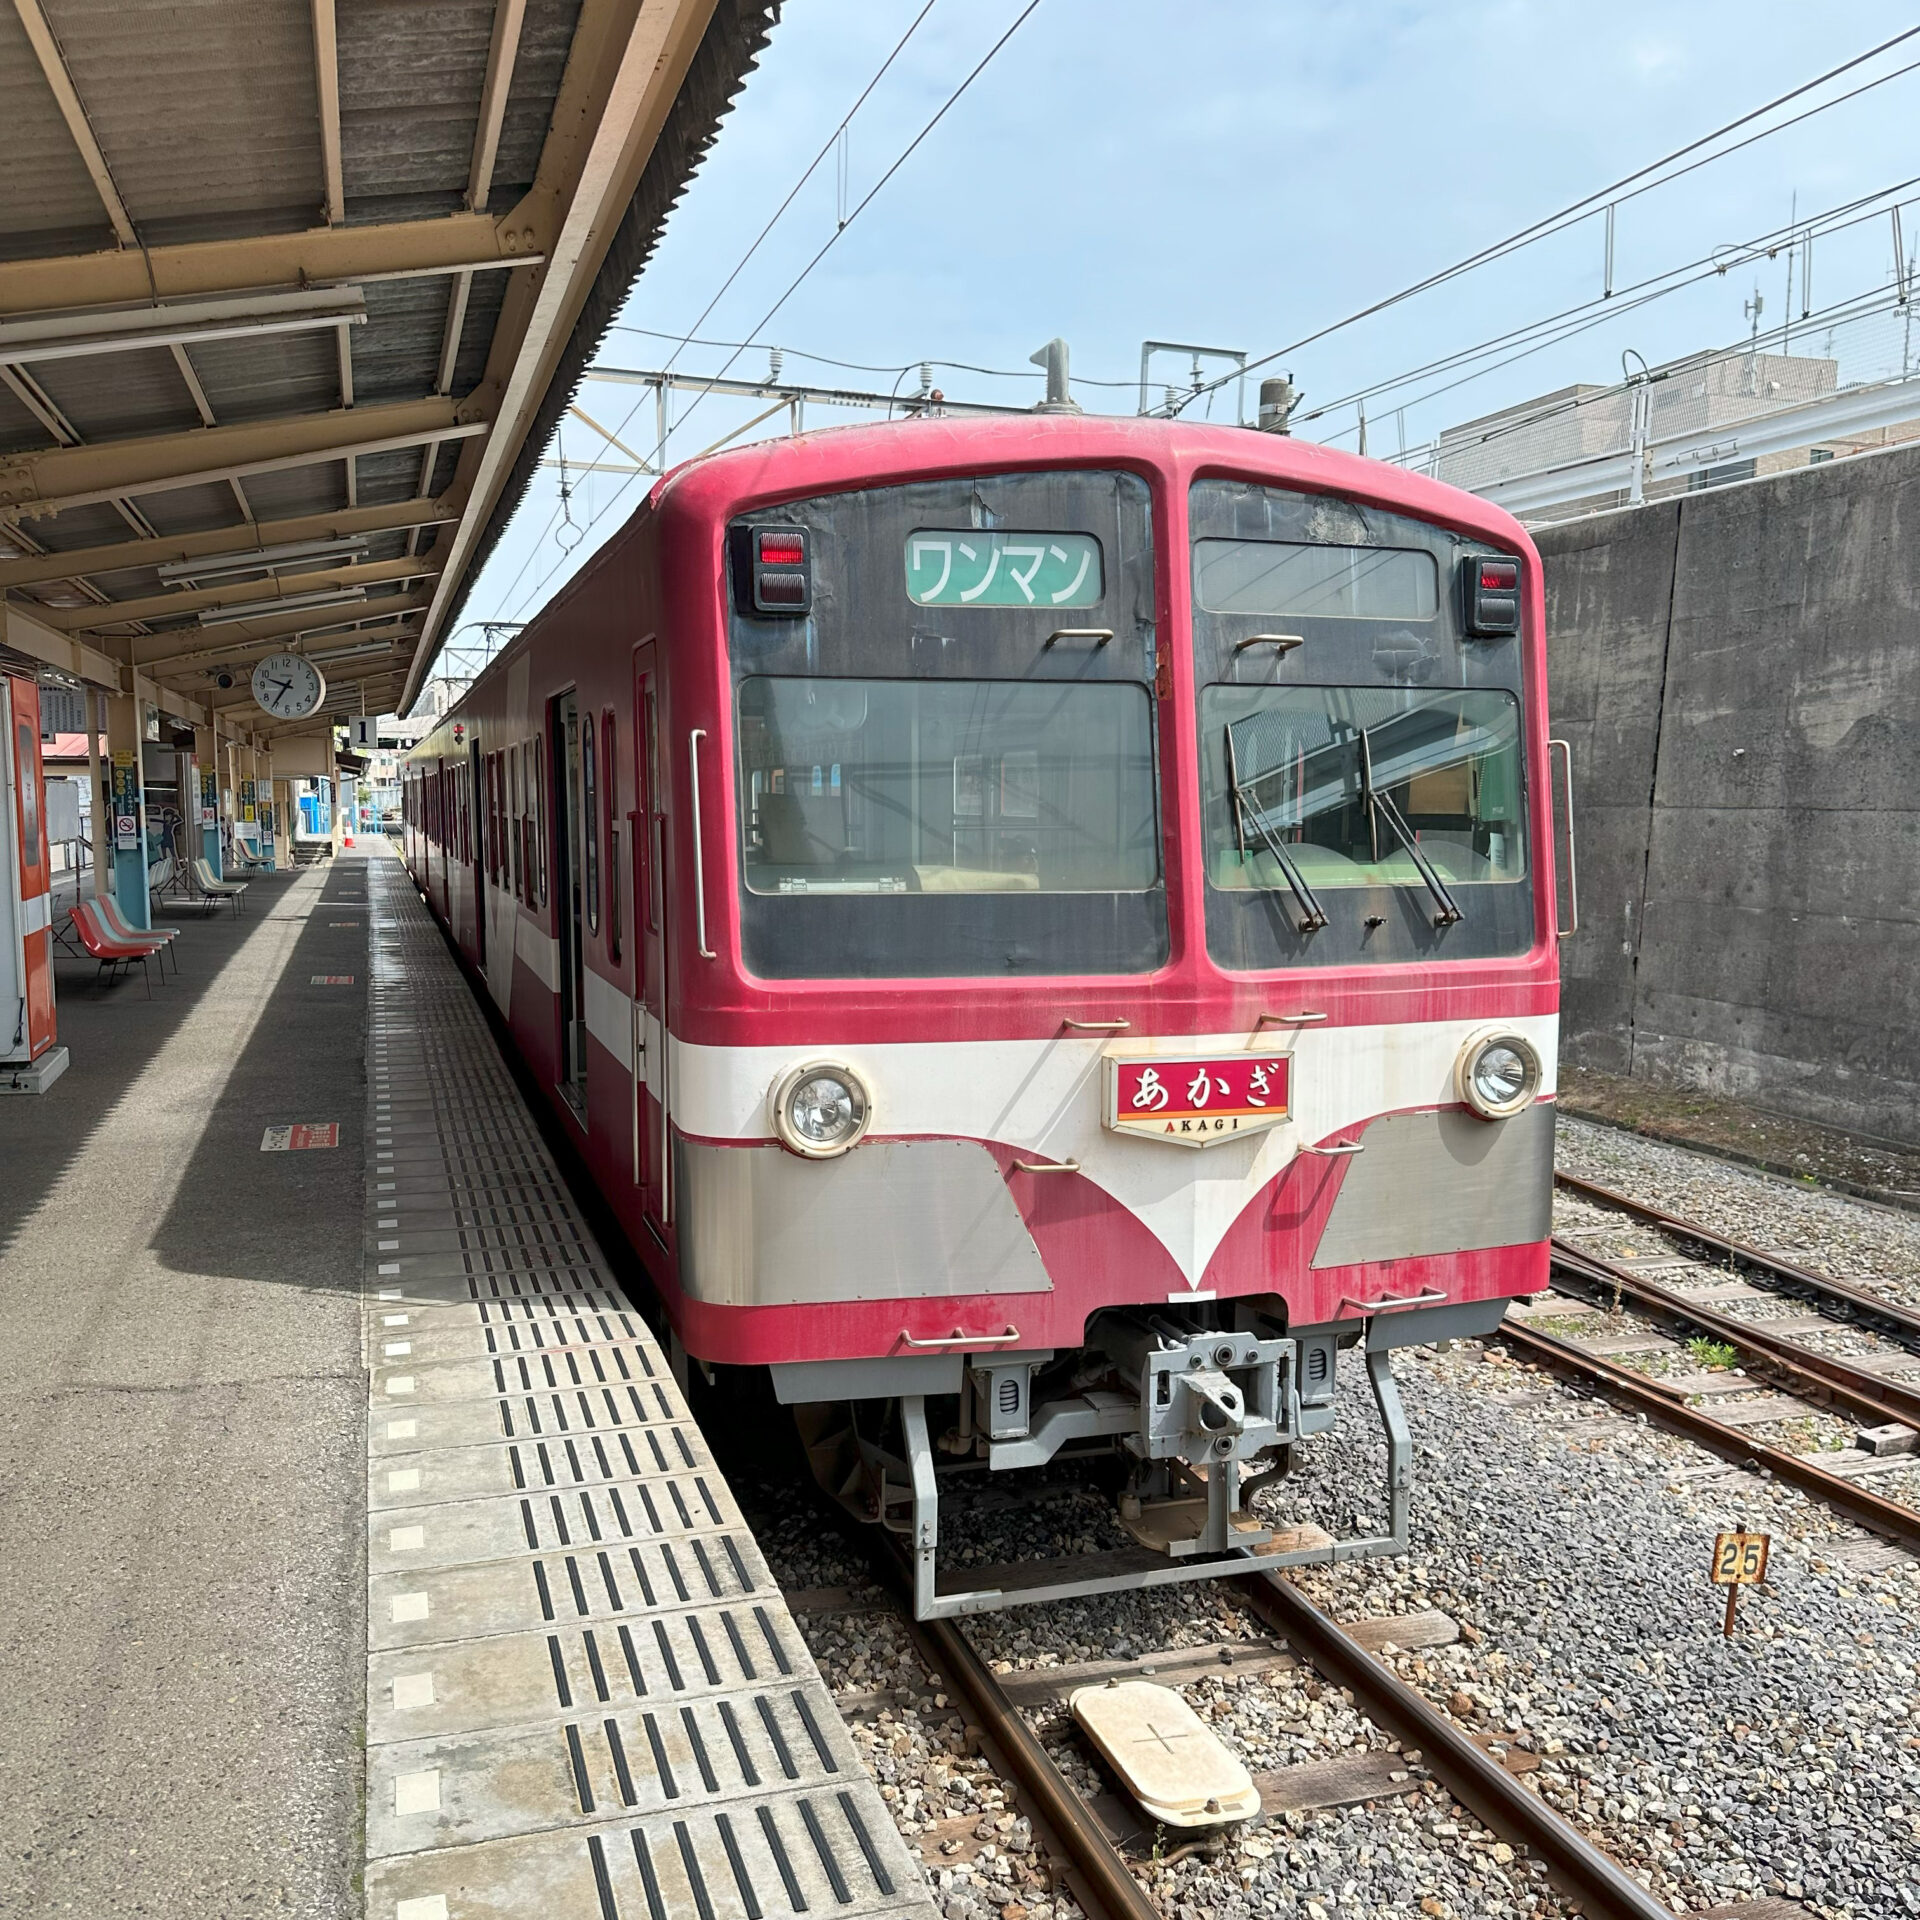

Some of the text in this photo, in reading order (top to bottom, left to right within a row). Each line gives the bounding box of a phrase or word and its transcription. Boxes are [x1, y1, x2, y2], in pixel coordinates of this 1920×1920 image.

[912, 540, 1092, 604] ワンマン
[271, 661, 278, 670] 11
[282, 658, 291, 667] 12
[261, 670, 270, 678] 10
[305, 670, 311, 679] 2
[259, 681, 265, 689] 9
[308, 682, 314, 691] 3
[263, 693, 270, 701] 8
[304, 695, 311, 703] 4
[284, 705, 290, 714] 6
[296, 702, 302, 711] 5
[358, 721, 368, 743] 1
[1132, 1062, 1279, 1112] あかぎ
[1165, 1118, 1239, 1133] AKAGI
[1720, 1543, 1760, 1576] 25
